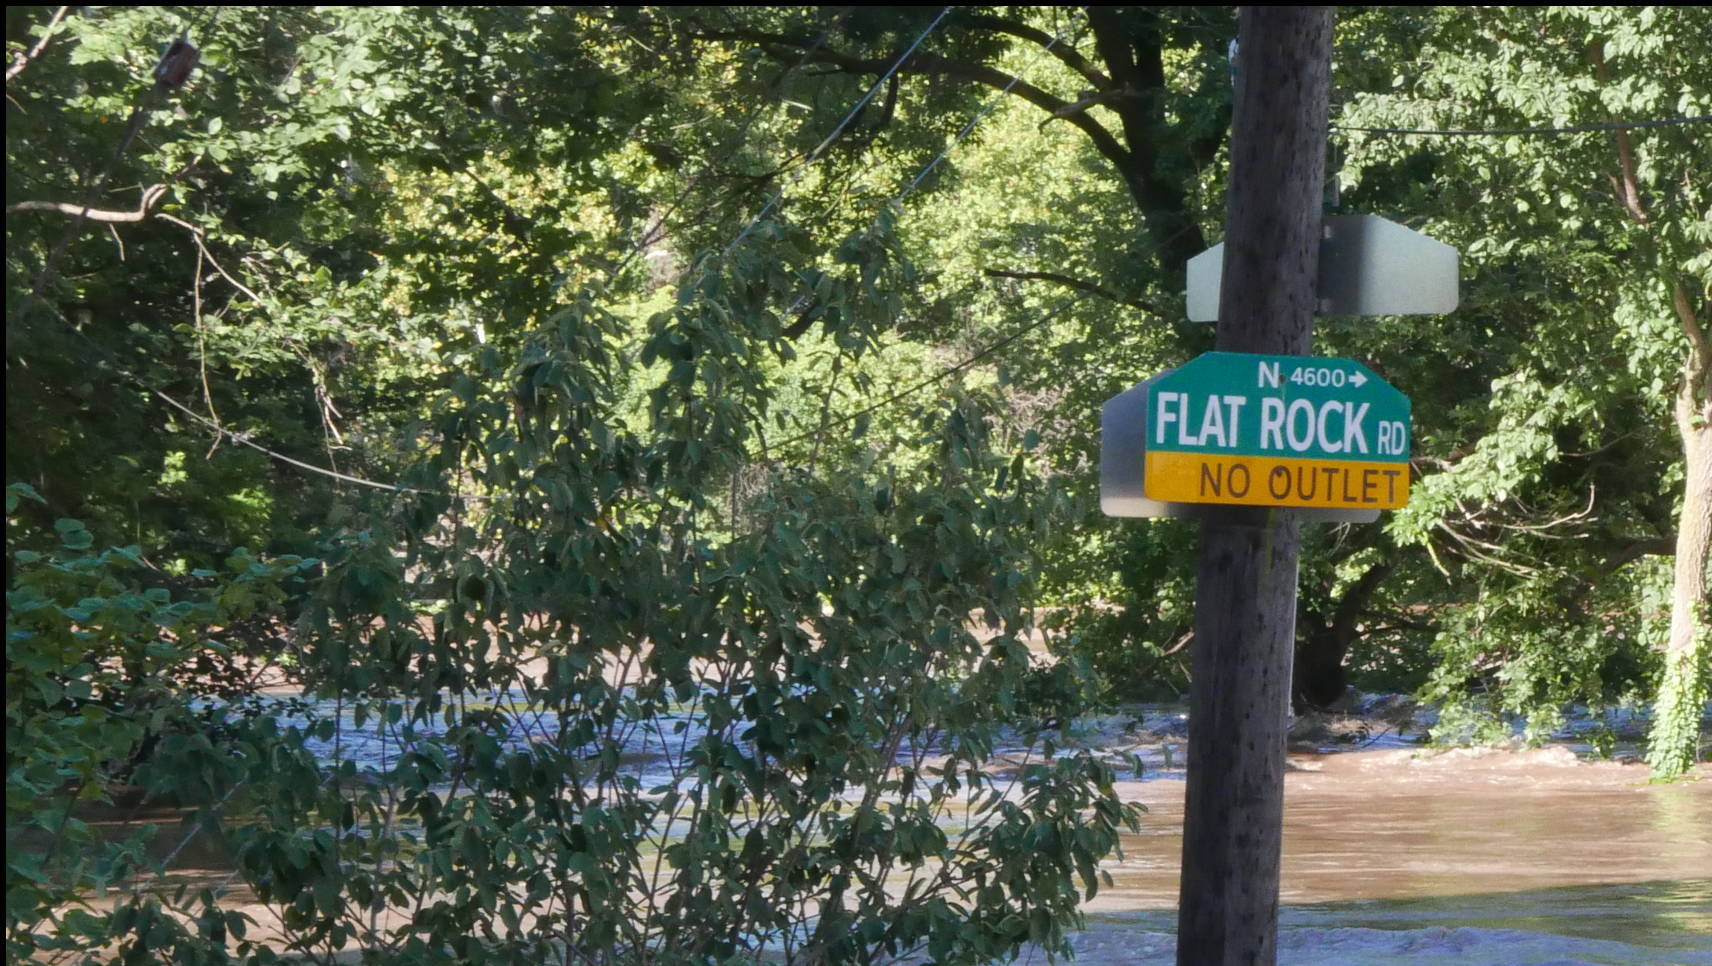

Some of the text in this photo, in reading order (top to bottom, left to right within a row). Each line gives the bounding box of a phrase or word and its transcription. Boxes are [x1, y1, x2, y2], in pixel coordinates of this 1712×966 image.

[1258, 361, 1345, 388] N 4600
[1156, 391, 1406, 456] FLAT ROCK RD
[1200, 462, 1401, 504] NO OUTLET
